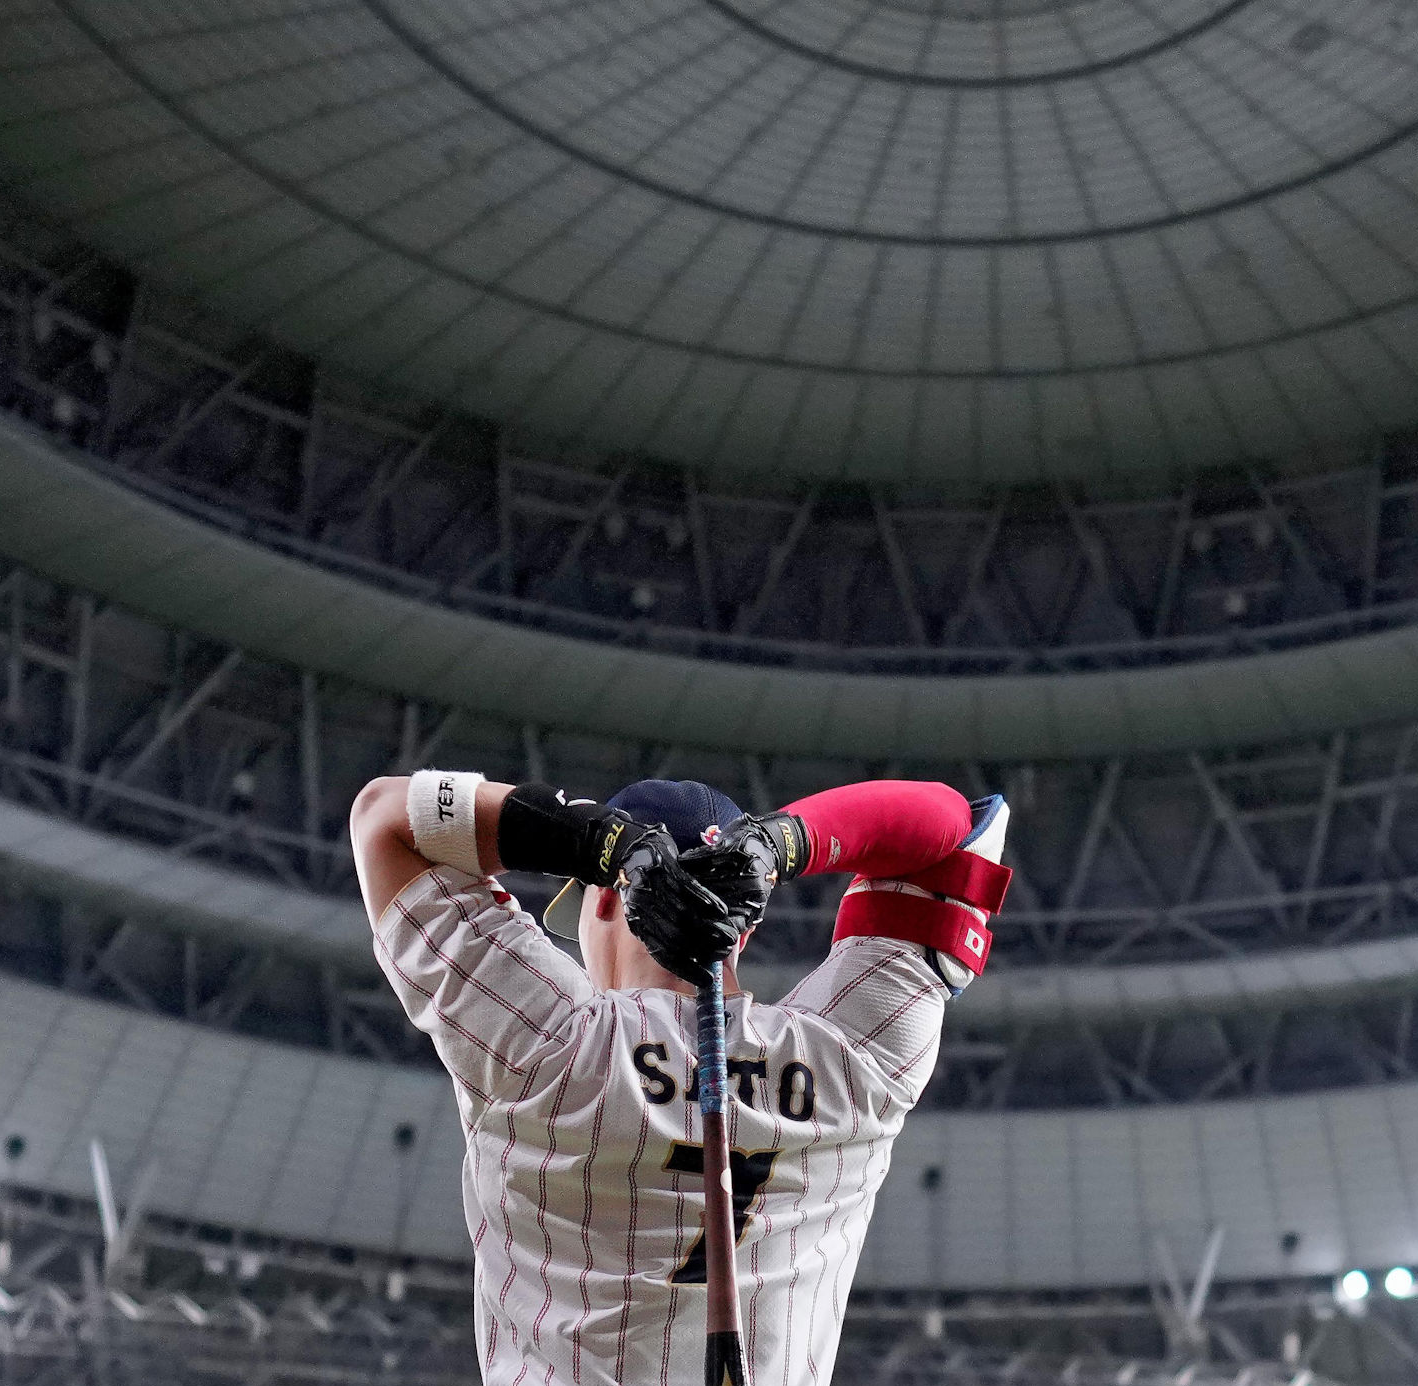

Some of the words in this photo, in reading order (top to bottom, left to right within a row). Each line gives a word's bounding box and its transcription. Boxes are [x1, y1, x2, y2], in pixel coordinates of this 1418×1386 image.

[599, 823, 626, 873] TERU
[779, 822, 796, 872] TERU
[661, 1138, 786, 1287] 7
